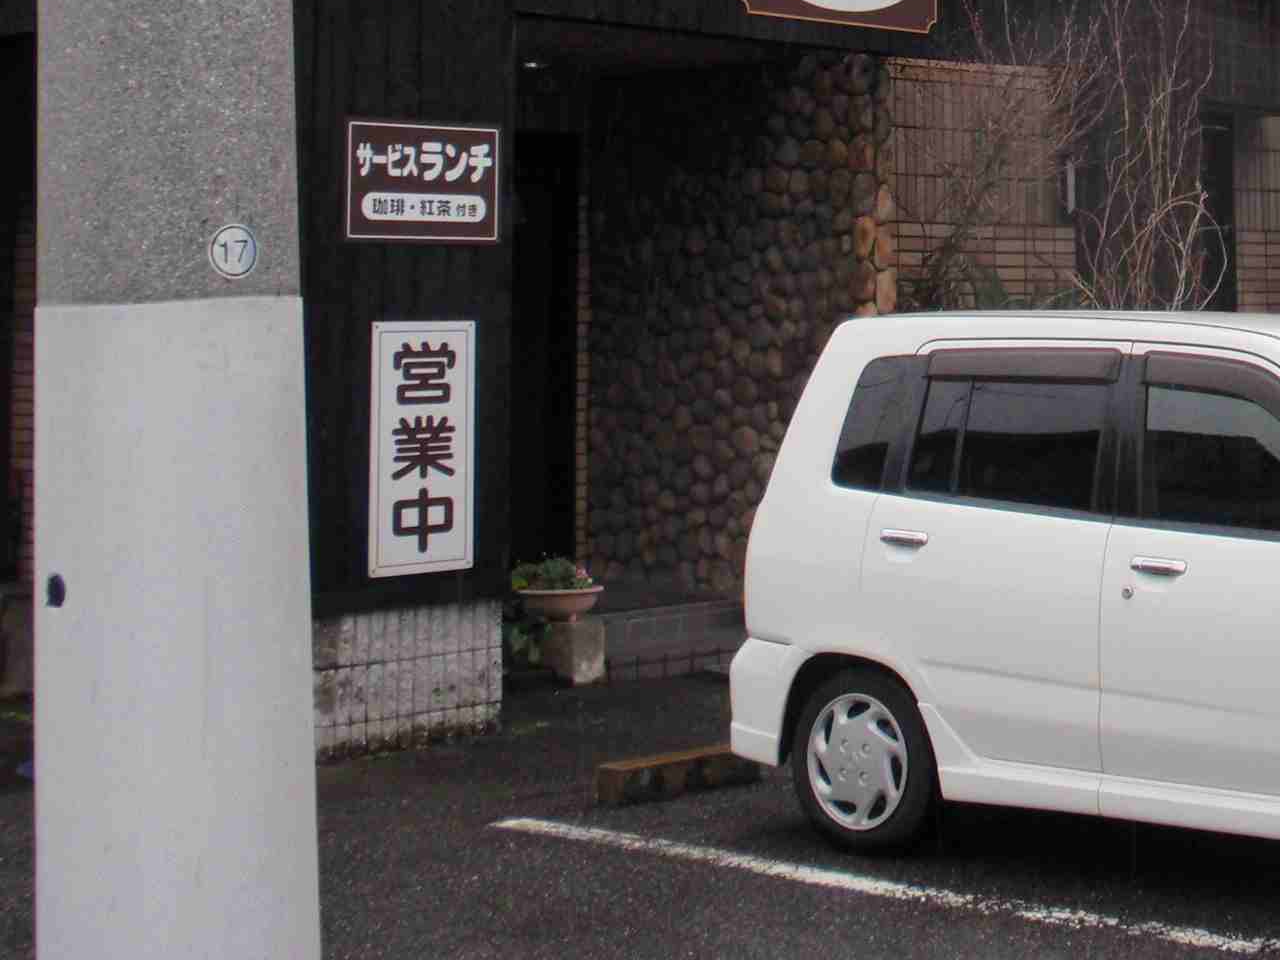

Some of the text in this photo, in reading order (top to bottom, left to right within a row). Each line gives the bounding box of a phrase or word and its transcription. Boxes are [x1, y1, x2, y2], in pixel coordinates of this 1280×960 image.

[356, 142, 493, 183] サービスランチ
[219, 239, 248, 265] 17
[391, 341, 456, 554] 営業中
